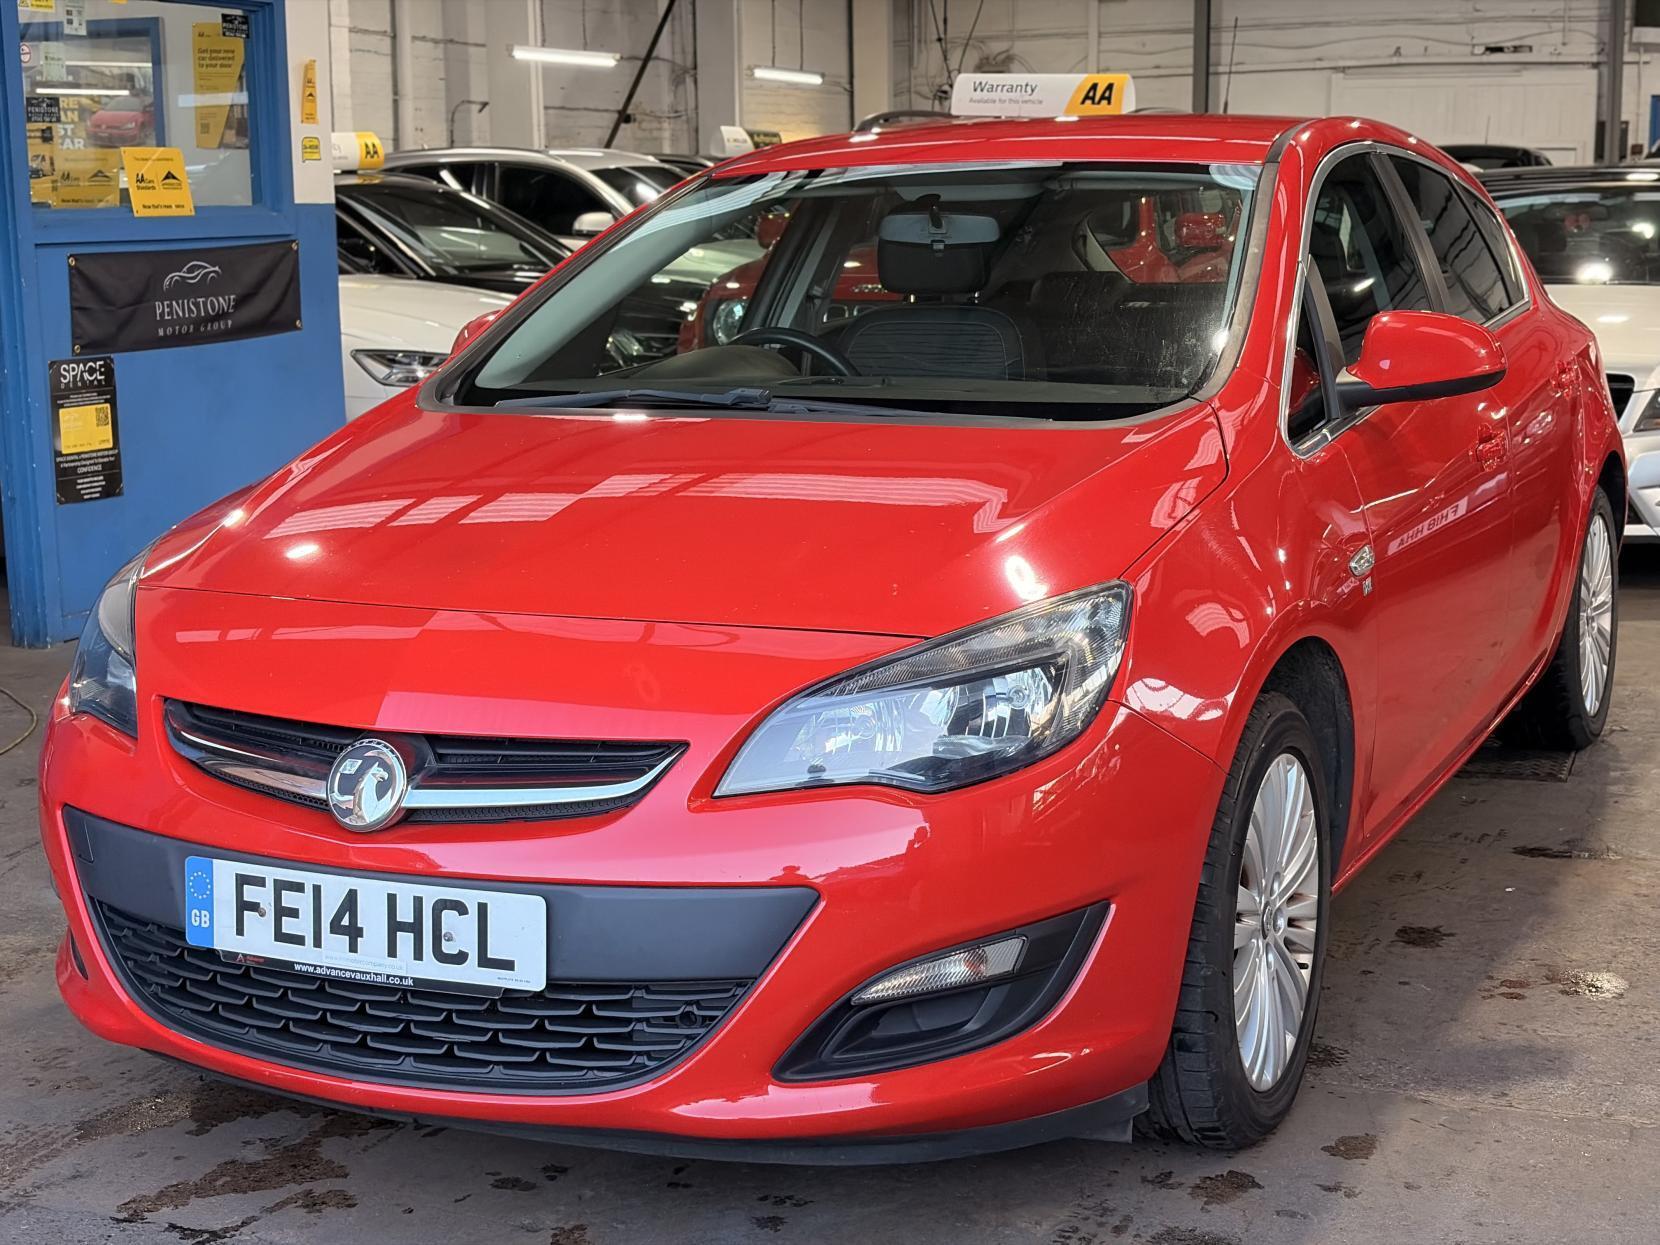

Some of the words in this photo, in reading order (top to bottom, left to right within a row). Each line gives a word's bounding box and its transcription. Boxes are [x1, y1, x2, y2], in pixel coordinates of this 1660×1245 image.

[973, 81, 1038, 96] Warranty
[1080, 82, 1115, 105] AA
[364, 142, 380, 159] AA
[155, 294, 236, 320] PENISTONE
[158, 324, 194, 336] MOTOR
[200, 320, 232, 332] GROUP
[60, 361, 105, 383] SPACE
[60, 379, 105, 389] DENTAL
[77, 464, 102, 474] CONFIDENCE
[191, 908, 210, 928] GB
[234, 872, 364, 954] FE14
[386, 892, 516, 972] HCL
[294, 962, 414, 986] www.advancevauxhall.co.uk
